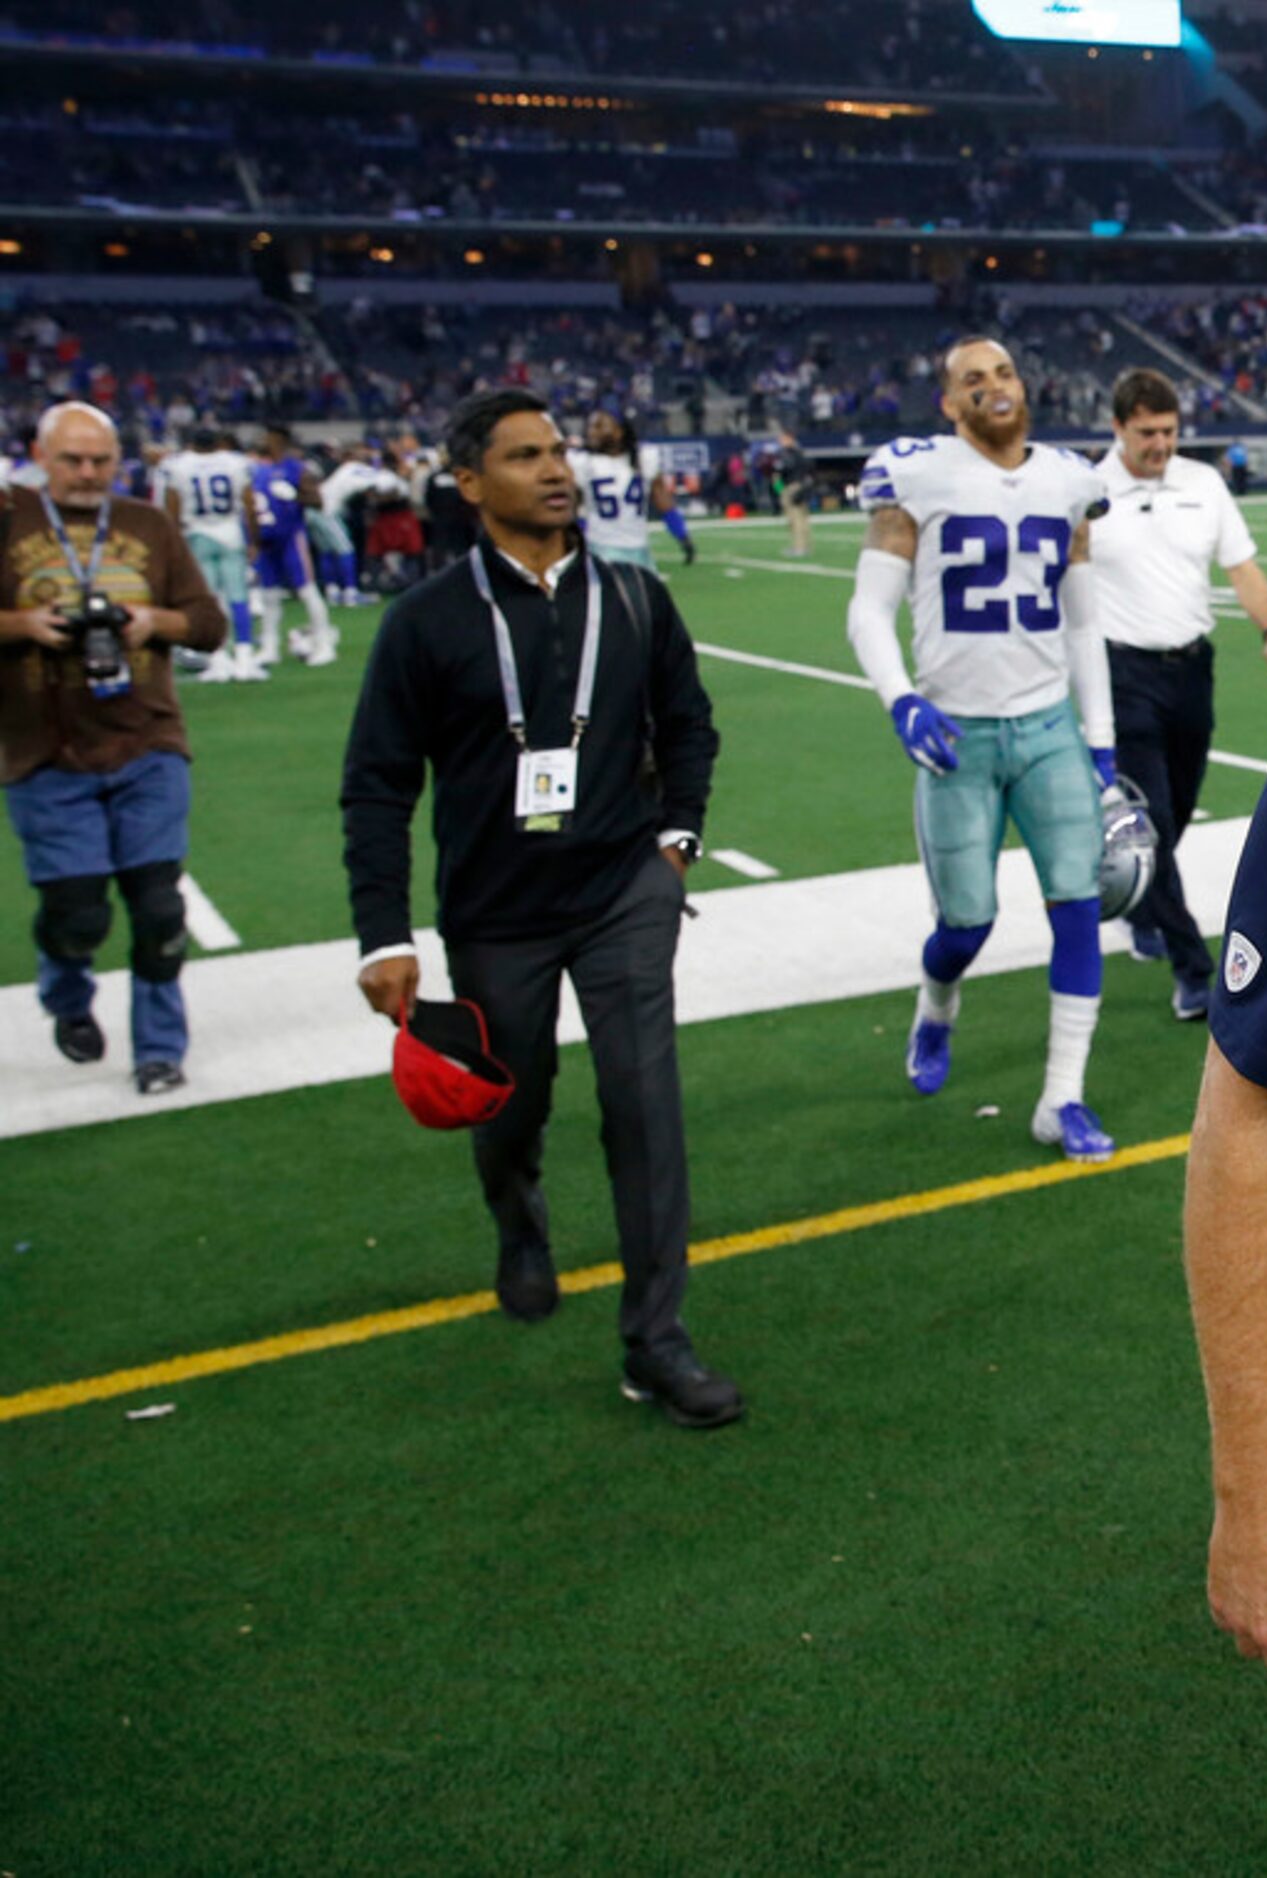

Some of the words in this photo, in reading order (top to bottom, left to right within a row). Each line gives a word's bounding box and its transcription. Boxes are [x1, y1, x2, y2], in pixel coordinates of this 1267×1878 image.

[189, 474, 234, 516] 19
[591, 475, 644, 520] 54
[940, 514, 1072, 633] 23
